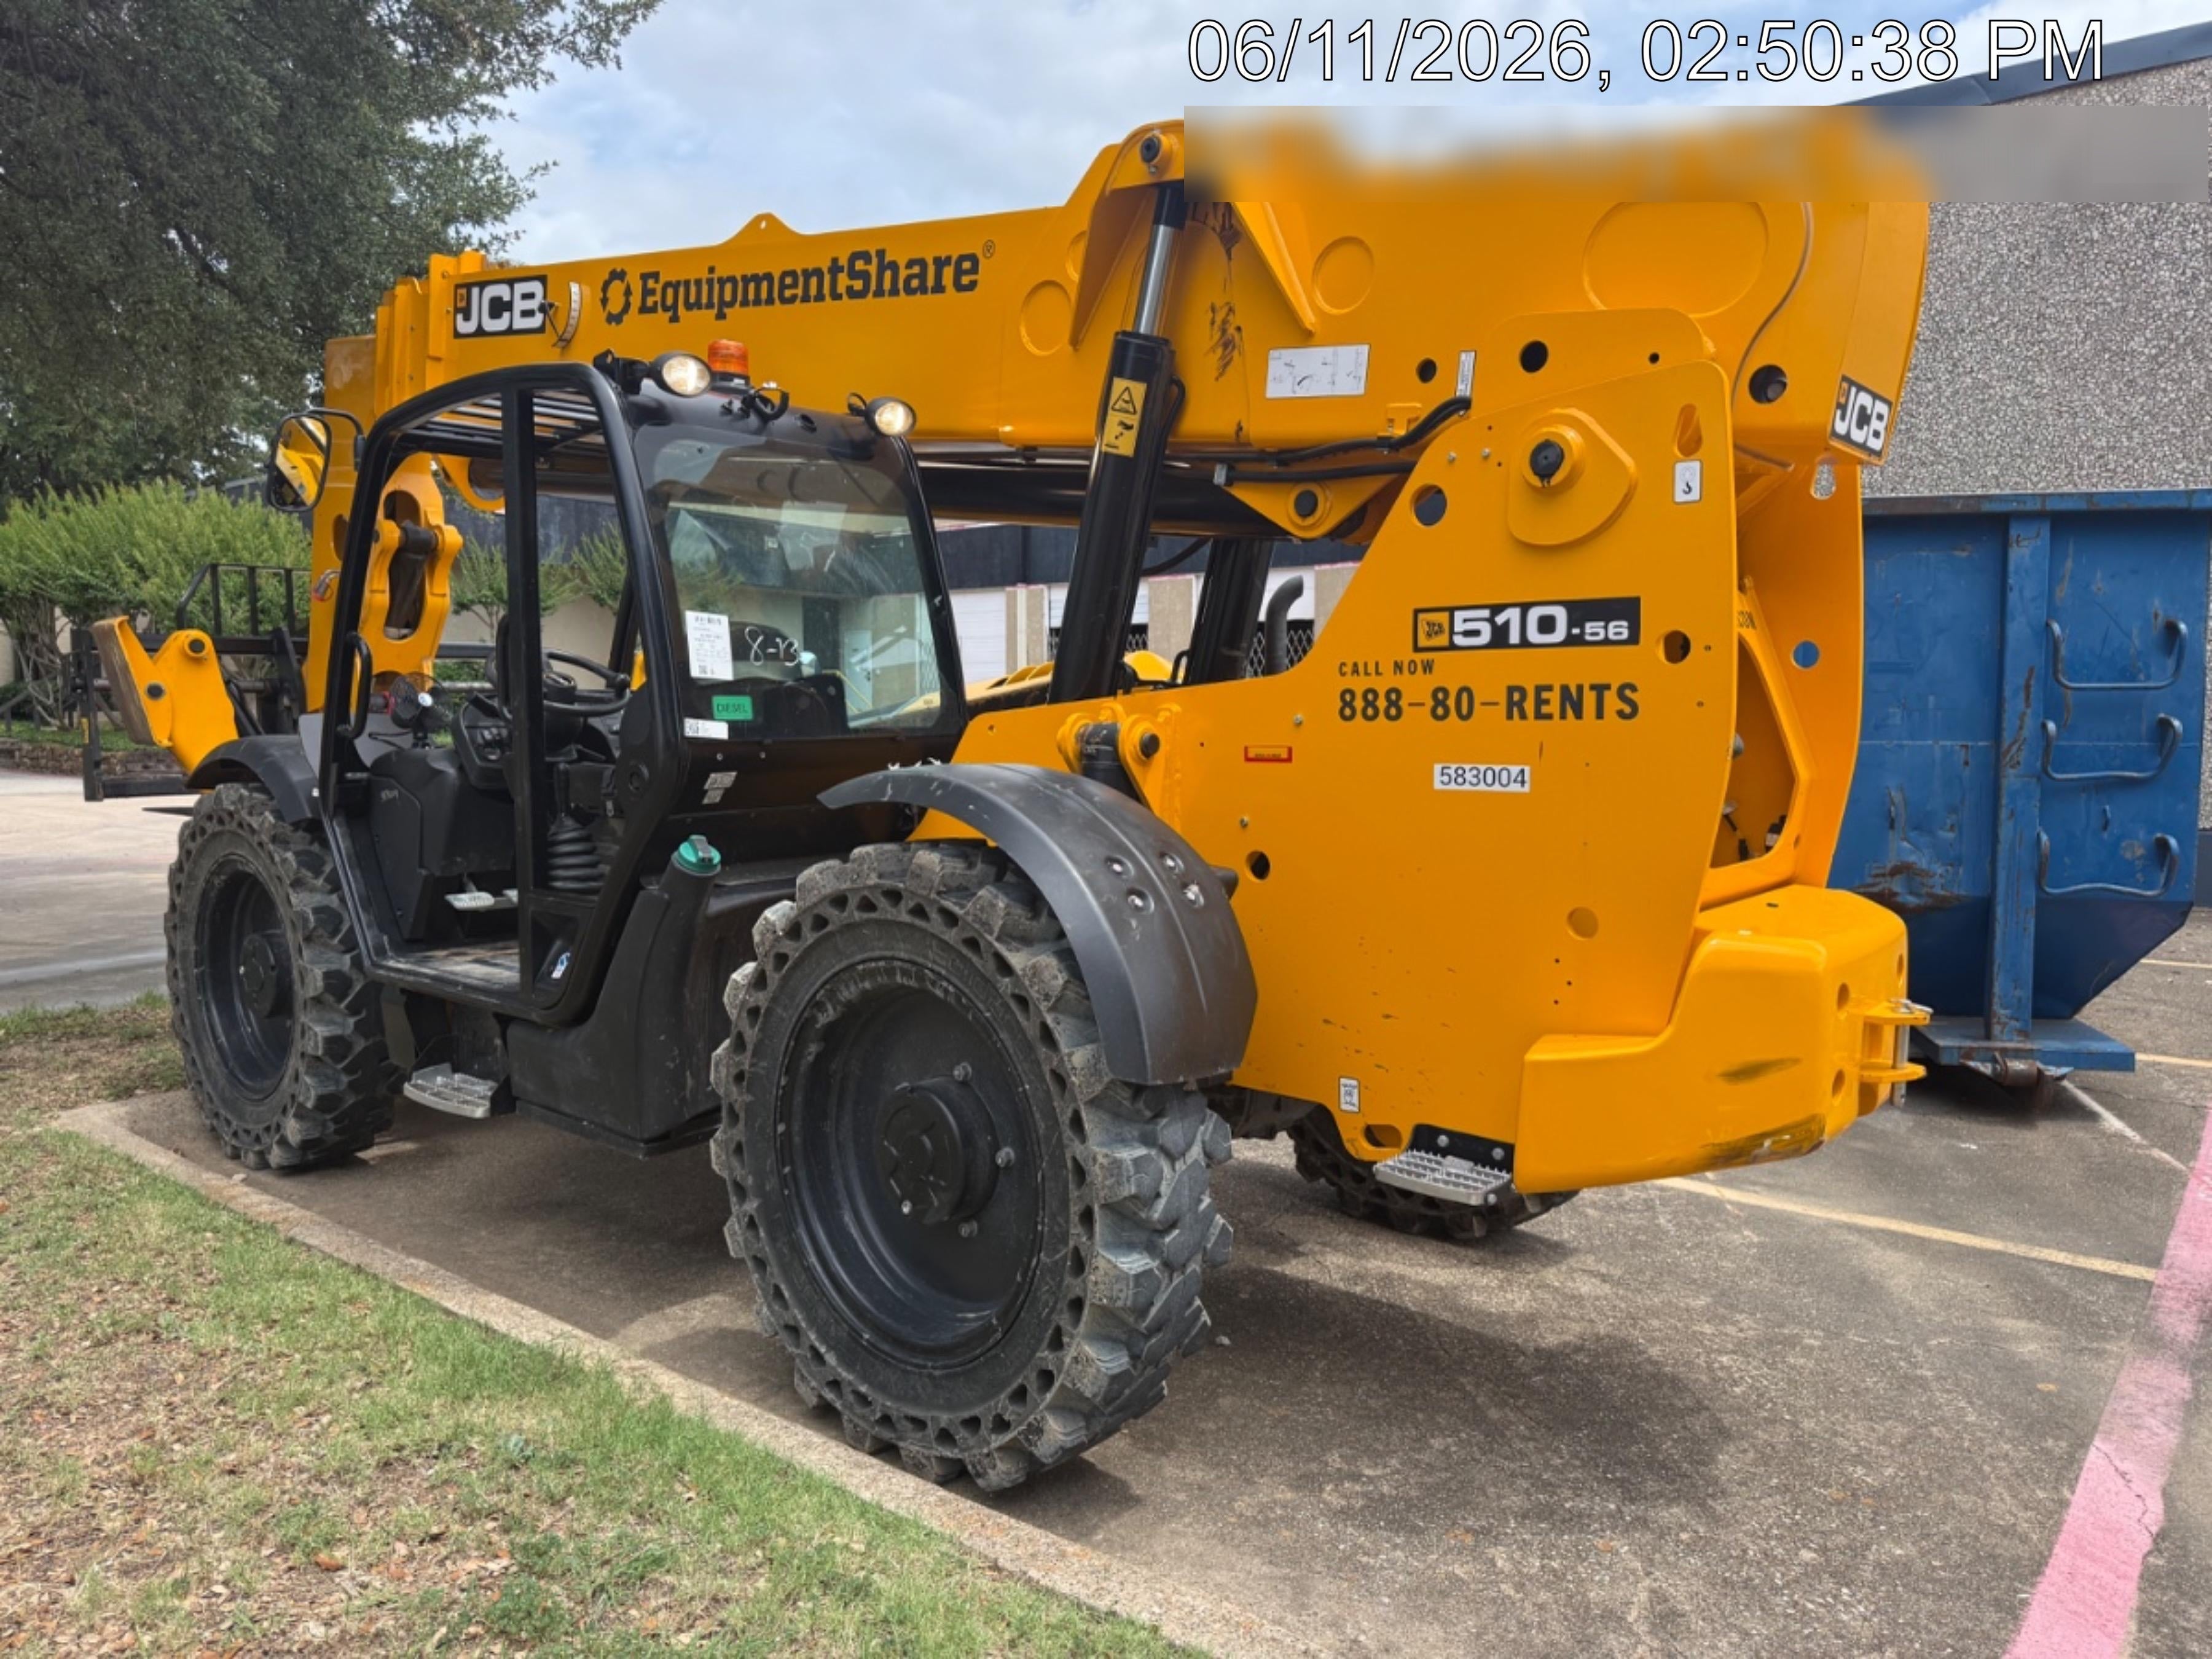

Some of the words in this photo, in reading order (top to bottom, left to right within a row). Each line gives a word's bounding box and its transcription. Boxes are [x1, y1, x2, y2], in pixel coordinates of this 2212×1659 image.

[456, 279, 545, 335] JCB
[1834, 386, 1889, 452] JCB
[1452, 604, 1630, 647] 510-56
[1338, 661, 1383, 678] CALL
[1394, 659, 1435, 676] NOW
[716, 702, 749, 714] DIESEL
[1338, 681, 1640, 722] 888-80-RENTS
[1438, 766, 1528, 788] 583004
